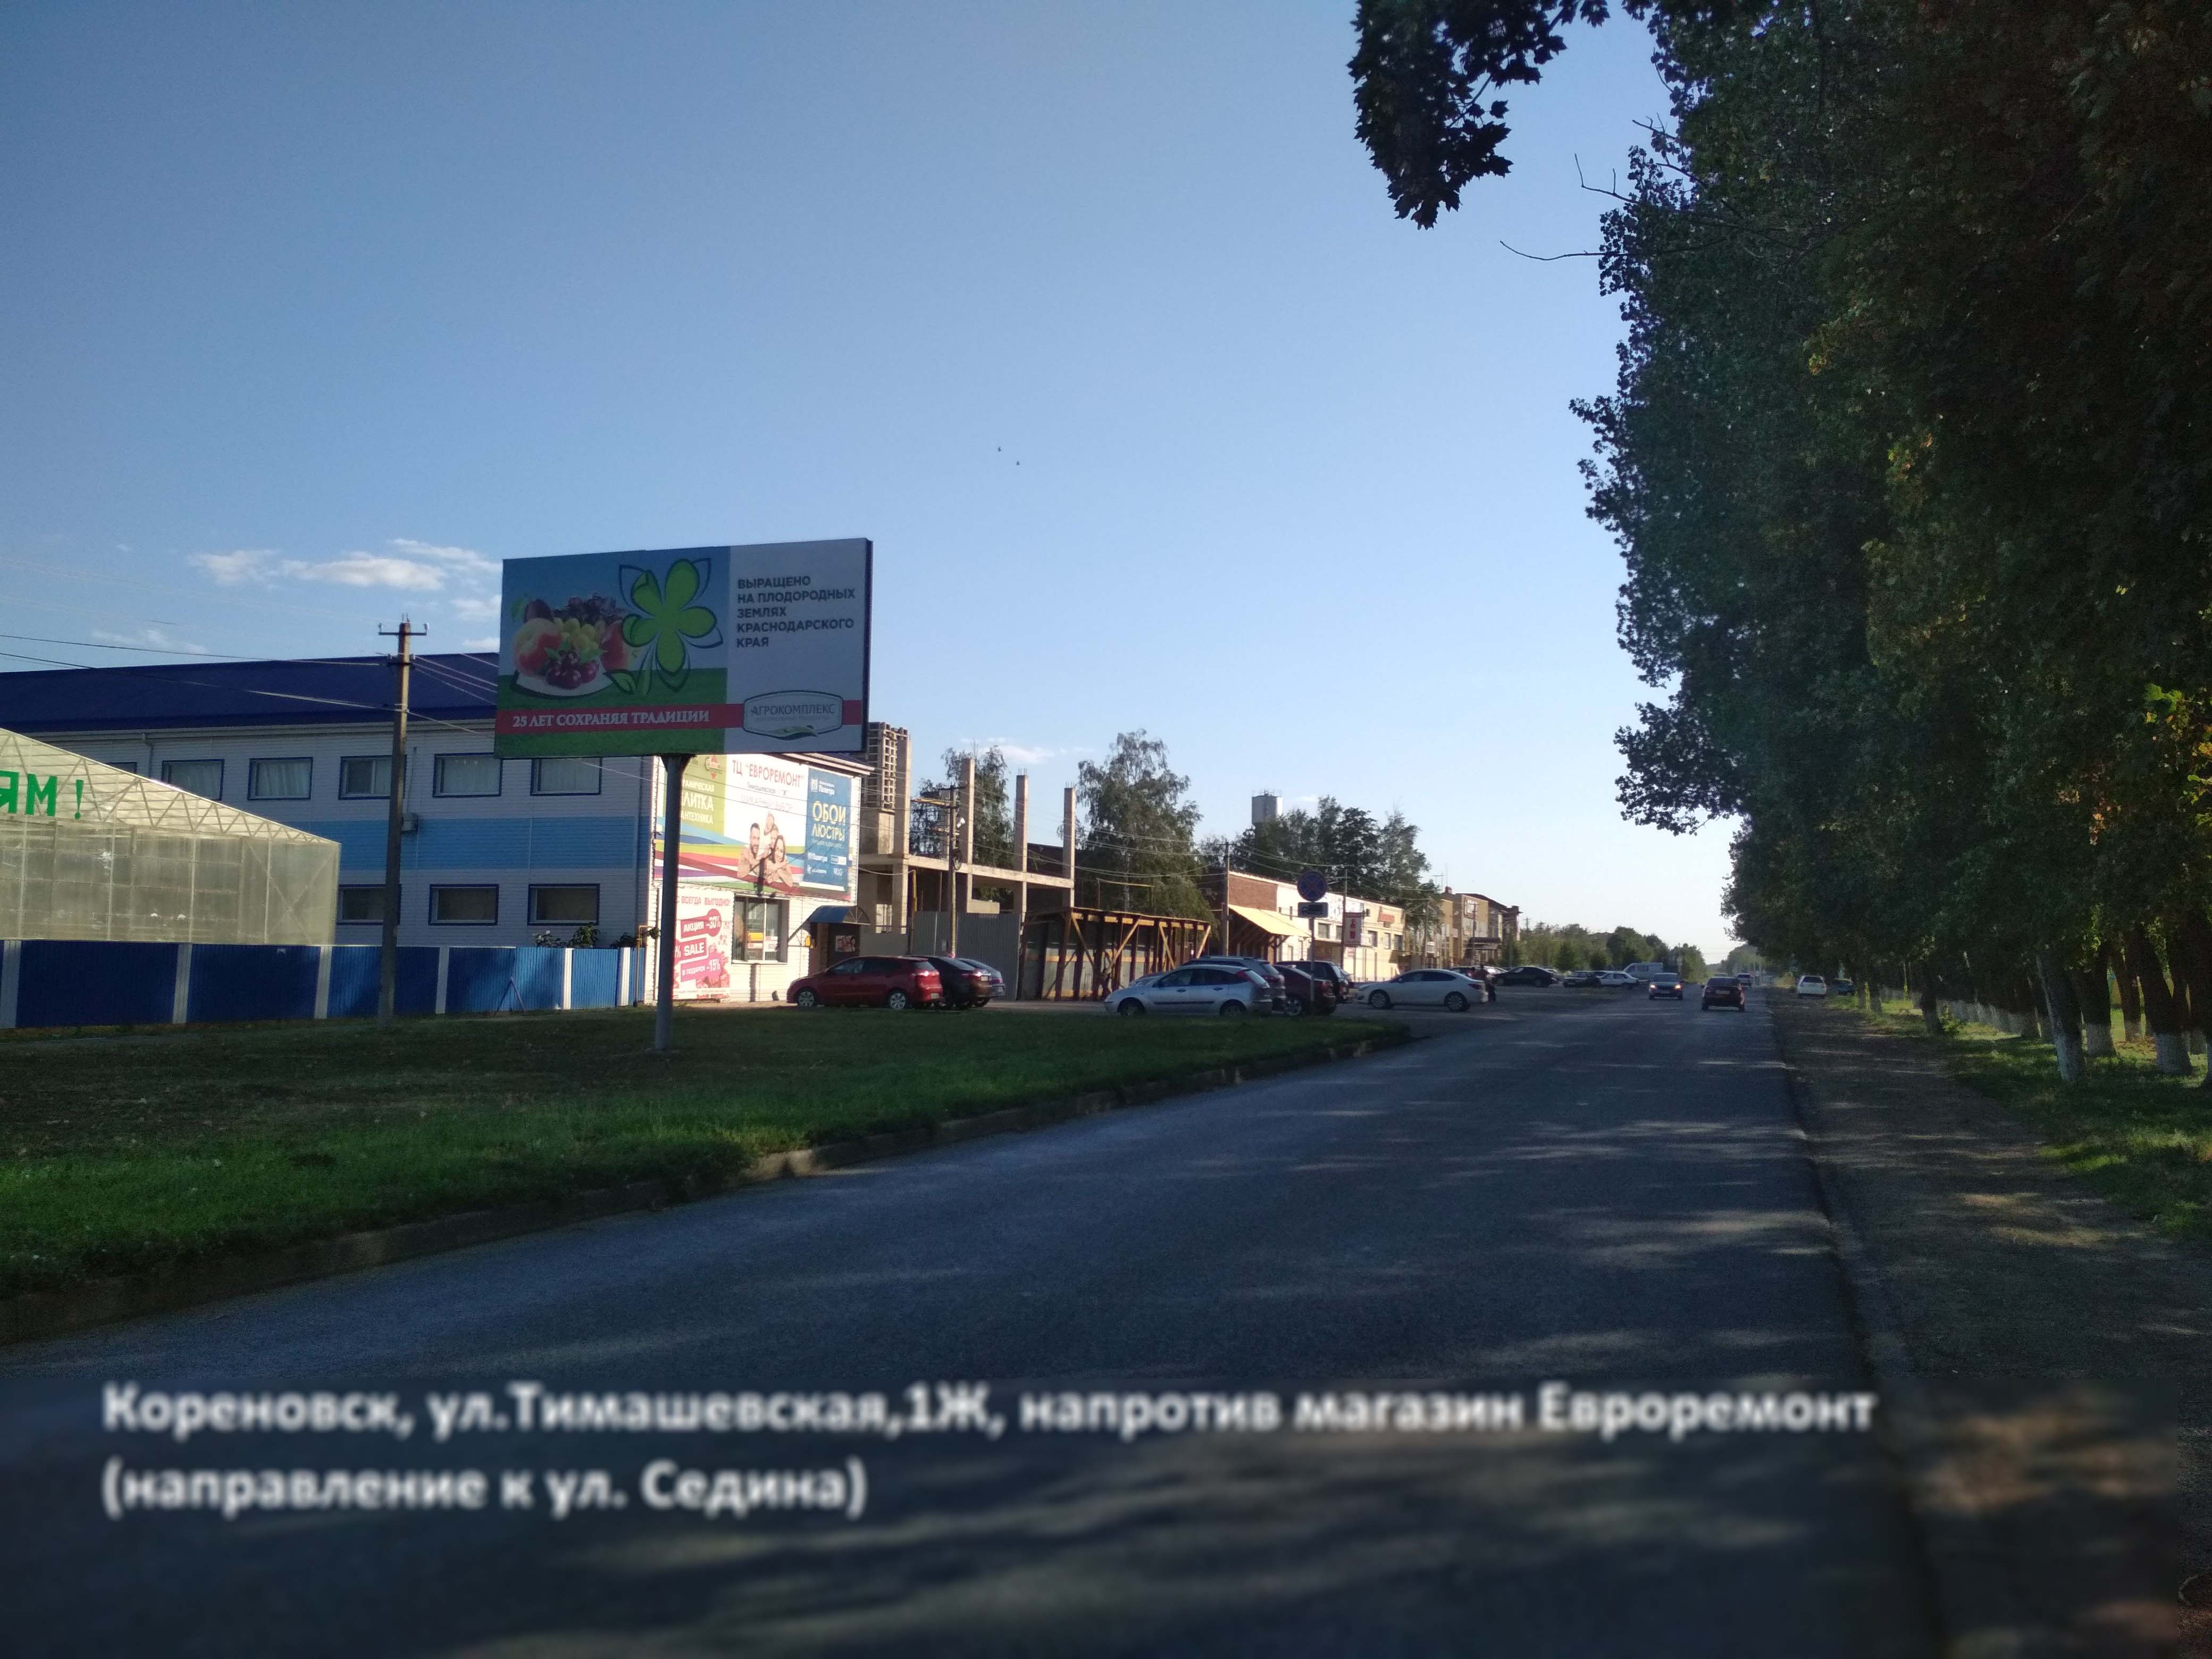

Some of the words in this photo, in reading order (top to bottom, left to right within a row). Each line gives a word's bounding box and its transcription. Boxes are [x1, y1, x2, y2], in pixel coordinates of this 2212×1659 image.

[738, 576, 811, 589] ВЫРАЩЕНО
[738, 593, 754, 604] НА
[758, 589, 855, 603] ПЛОДОРОДНЫХ
[737, 607, 786, 618] ЗЕМЛЯХ
[737, 618, 854, 633] КРАСНОДАРСКОГО
[736, 637, 769, 648] КРАЯ
[750, 704, 835, 716] АГРОКОМПЛЕКС
[513, 716, 527, 727] 25
[529, 715, 554, 727] ЛЕТ
[557, 713, 629, 726] СОХРАНЯЯ
[631, 710, 709, 724] ТРАДИЦИИ
[732, 760, 743, 777] ТЦ
[682, 778, 715, 792] РАМИЧЕСКАЯ
[681, 791, 714, 811] ЛИТКА
[680, 810, 714, 825] АНТЕХНИКА
[812, 801, 847, 825] ОБОИ
[811, 823, 845, 842] ЛЮСТРЫ
[681, 896, 701, 906] ВСЕГДА
[704, 897, 731, 906] ВЫГОДНО!
[683, 921, 705, 933] АКЦИЯ
[684, 942, 705, 956] SALE
